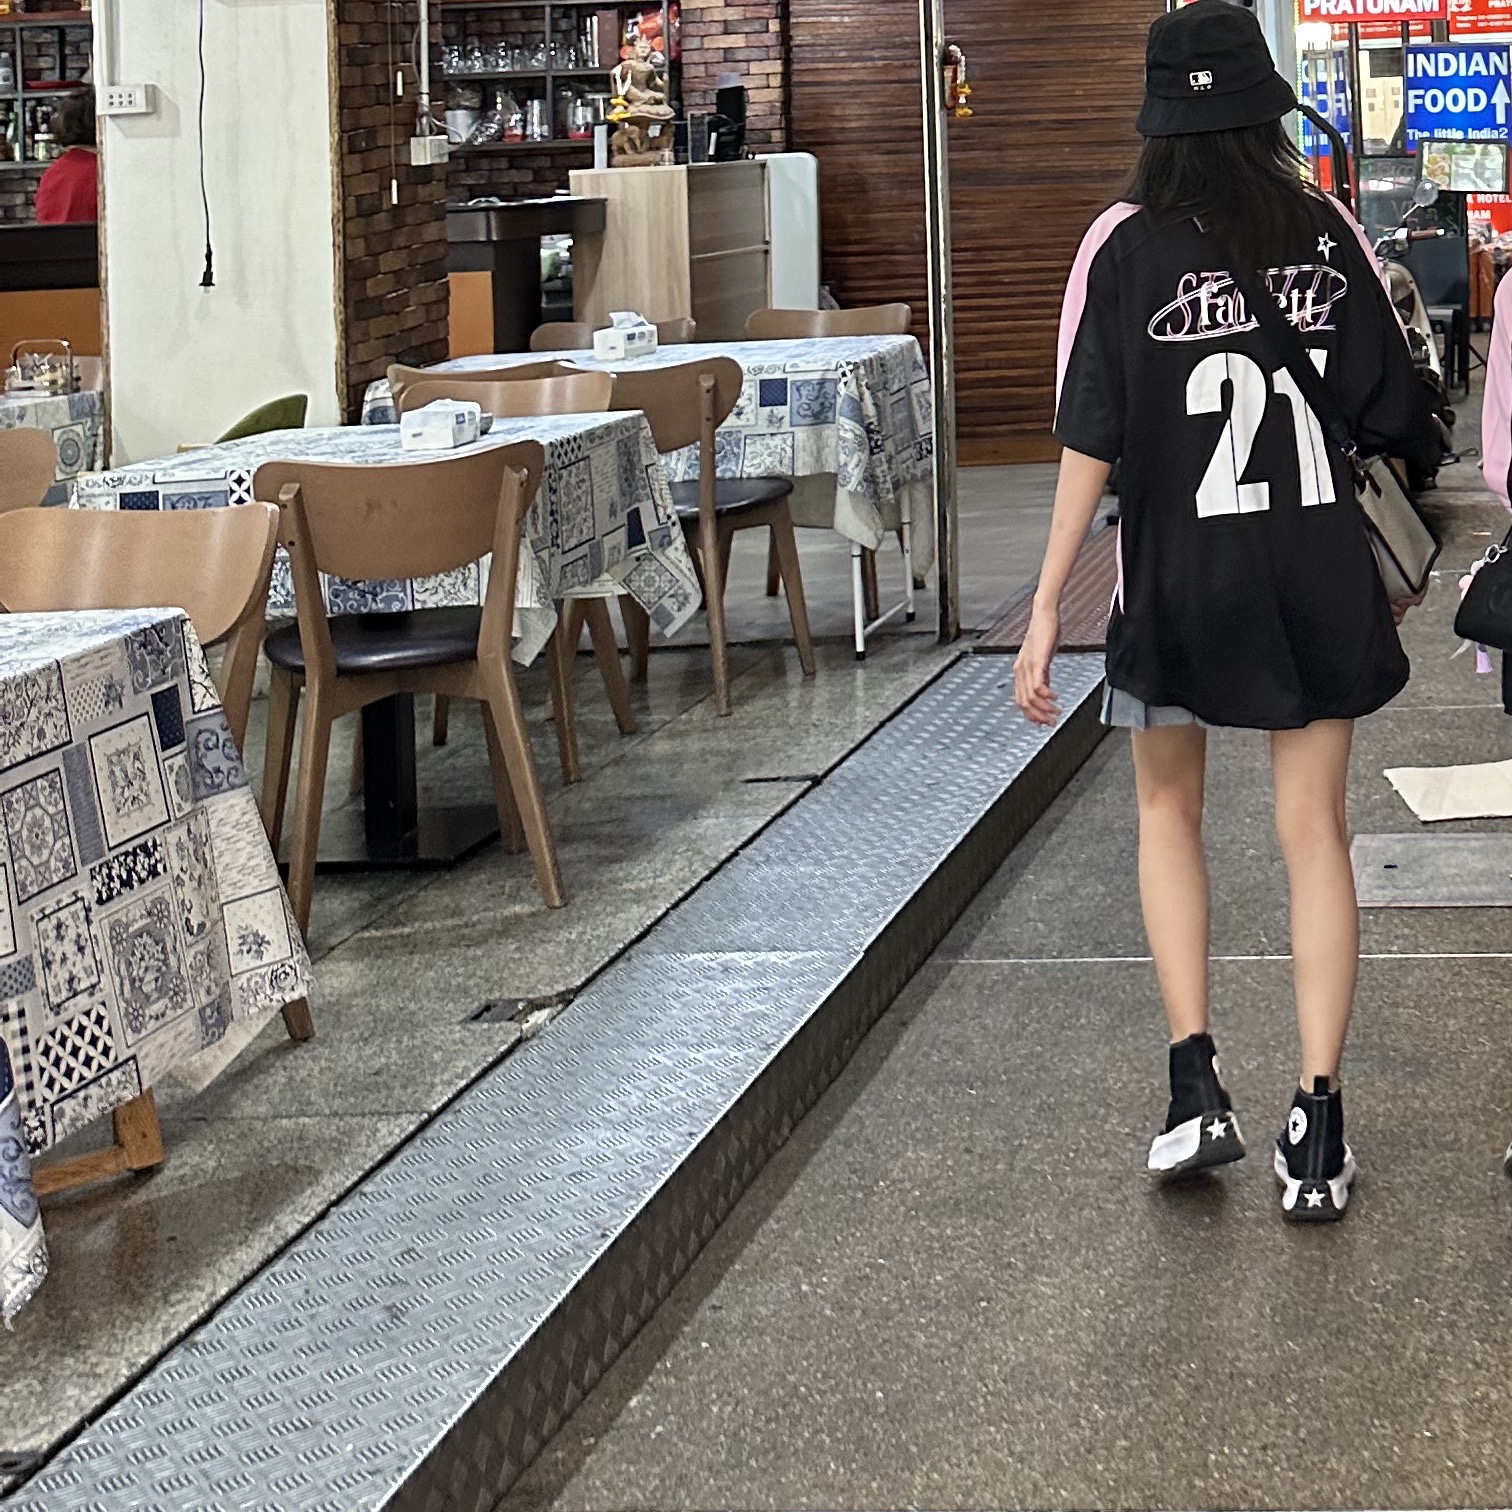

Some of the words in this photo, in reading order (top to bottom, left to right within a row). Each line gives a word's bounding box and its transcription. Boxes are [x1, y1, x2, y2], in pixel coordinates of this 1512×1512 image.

[1407, 51, 1508, 78] INDIAN
[1407, 87, 1488, 113] FOOD
[1406, 128, 1431, 140] The
[1186, 349, 1336, 519] 21
